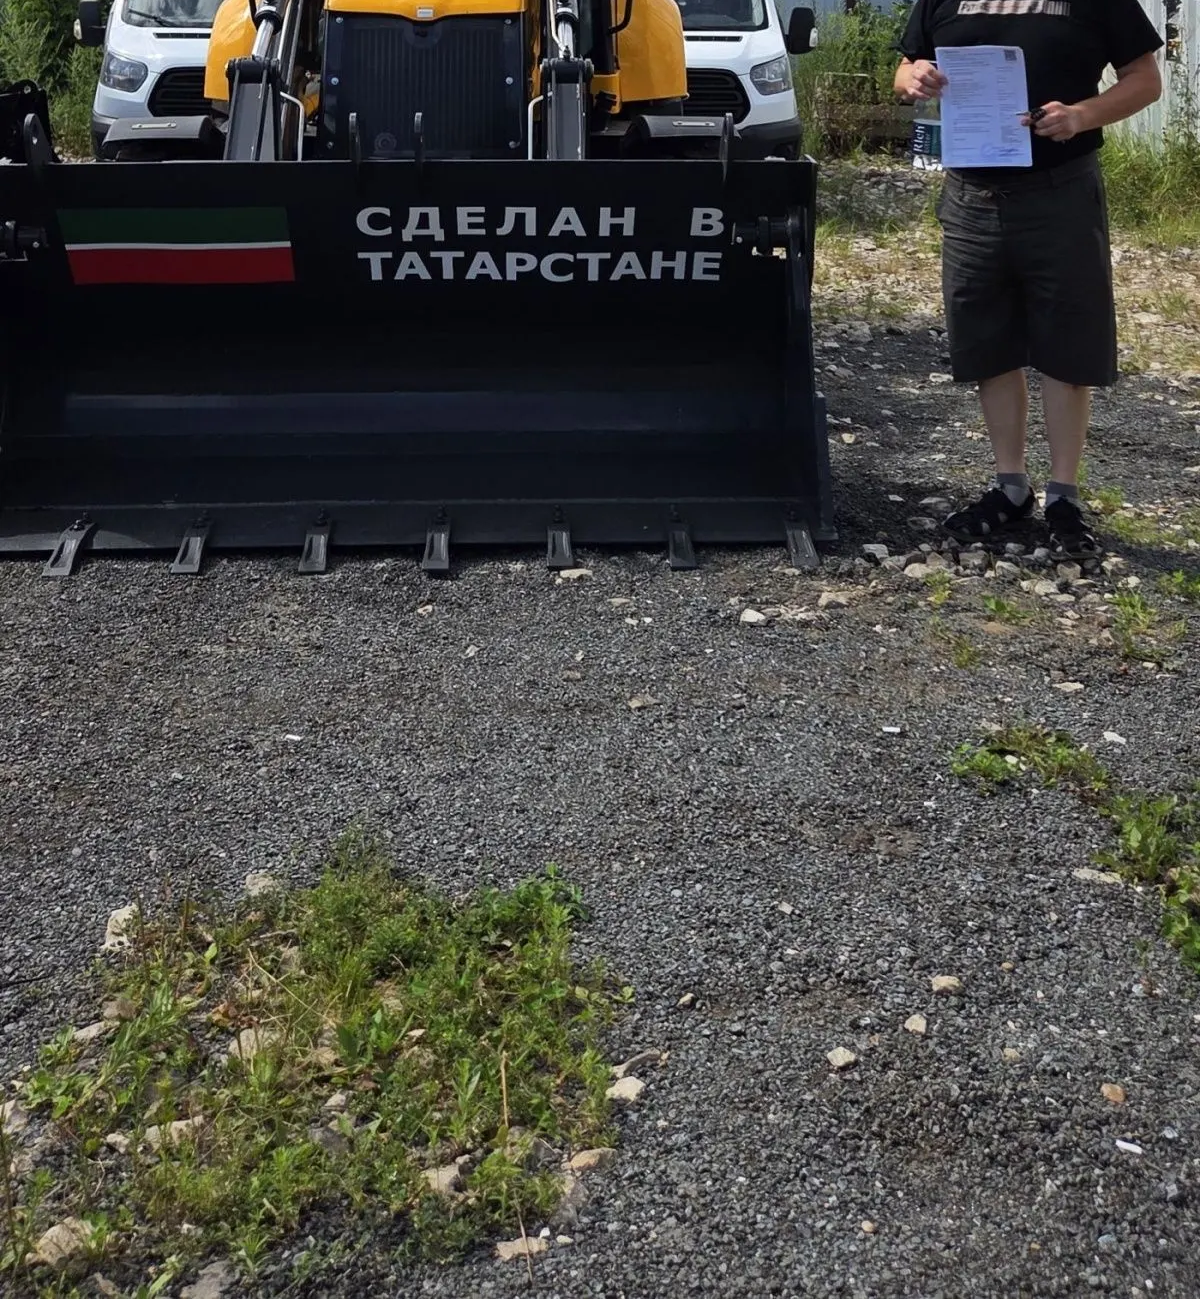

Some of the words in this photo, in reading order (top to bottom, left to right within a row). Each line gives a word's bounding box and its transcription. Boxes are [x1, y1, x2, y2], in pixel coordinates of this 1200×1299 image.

[355, 206, 636, 242] СДЕЛАН
[689, 207, 725, 237] В
[357, 251, 723, 282] ТАТАРСТАНЕ
